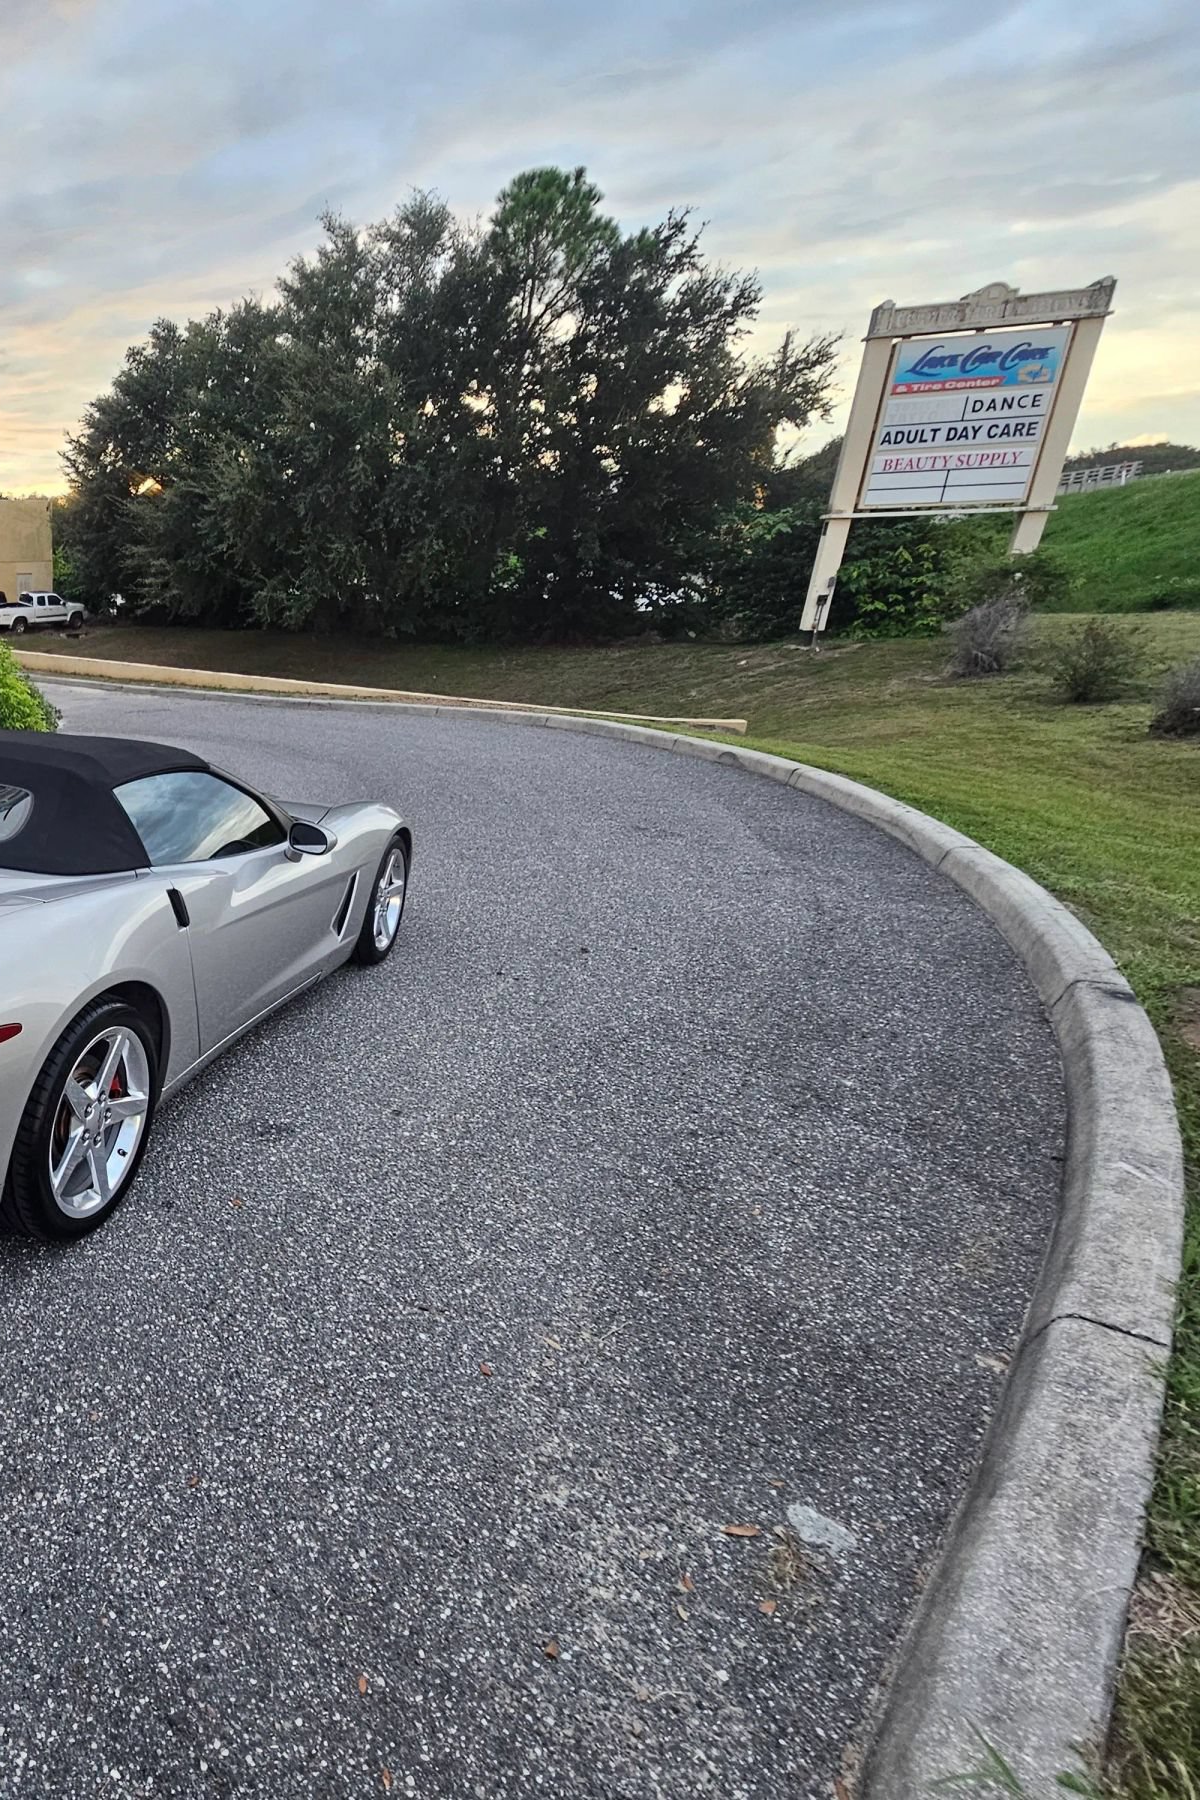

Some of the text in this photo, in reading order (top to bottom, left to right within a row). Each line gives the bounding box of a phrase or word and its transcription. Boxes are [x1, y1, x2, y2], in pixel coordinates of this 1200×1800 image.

[912, 381, 942, 391] Tire
[945, 378, 1000, 389] Center
[971, 394, 1044, 413] DANCE
[880, 421, 1040, 446] ADULT DAY CARE
[882, 451, 1024, 472] BEAUTY SUPPLY
